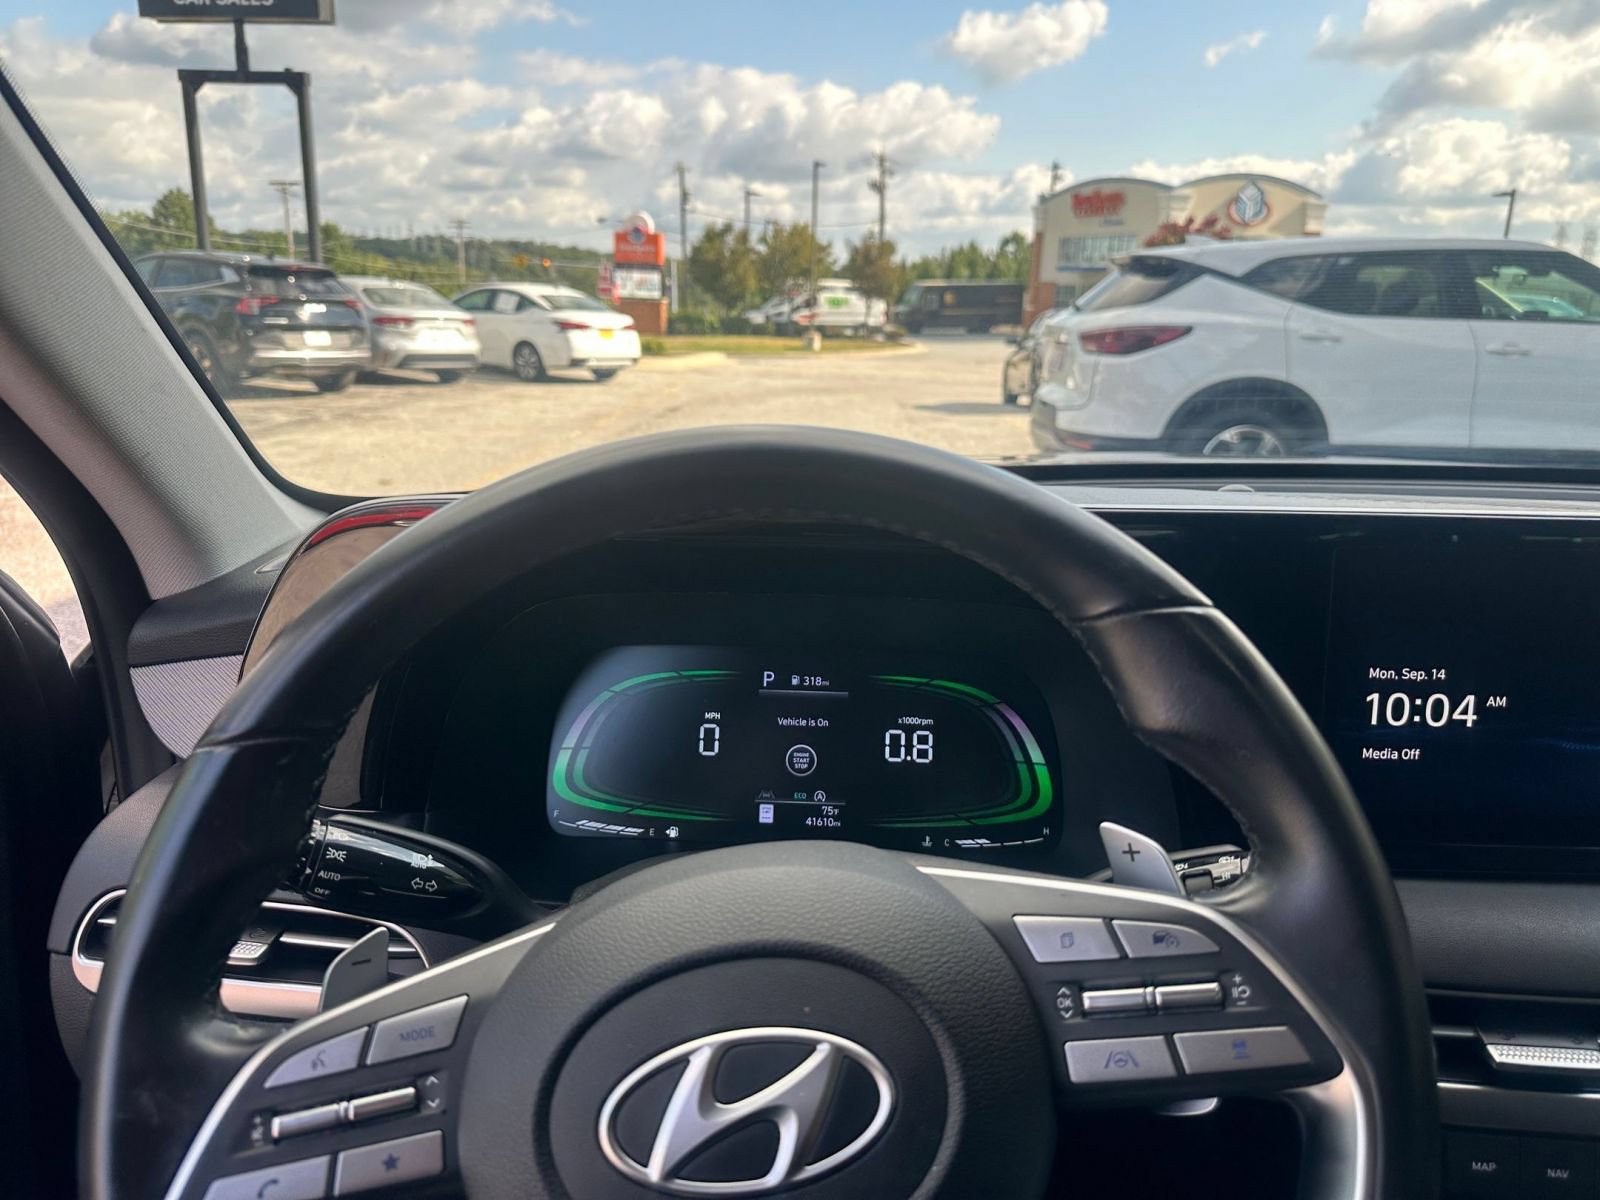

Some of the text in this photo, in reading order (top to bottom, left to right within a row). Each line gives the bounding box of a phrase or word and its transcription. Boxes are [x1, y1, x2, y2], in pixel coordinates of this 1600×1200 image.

[763, 671, 775, 687] P
[1401, 668, 1428, 682] Sep.
[1431, 668, 1446, 680] 14
[1366, 692, 1507, 727] 10:04 AM
[705, 712, 720, 720] MPH
[898, 717, 934, 726] x1000rpm
[777, 717, 829, 727] Vehicle is On
[699, 723, 720, 756] 0
[885, 729, 934, 763] 0.8
[1362, 748, 1421, 760] Media Off
[318, 870, 341, 881] AUTO
[314, 887, 330, 895] OFF
[399, 1025, 436, 1040] MODE
[1472, 1161, 1496, 1171] MAP
[1547, 1168, 1569, 1178] NAV
